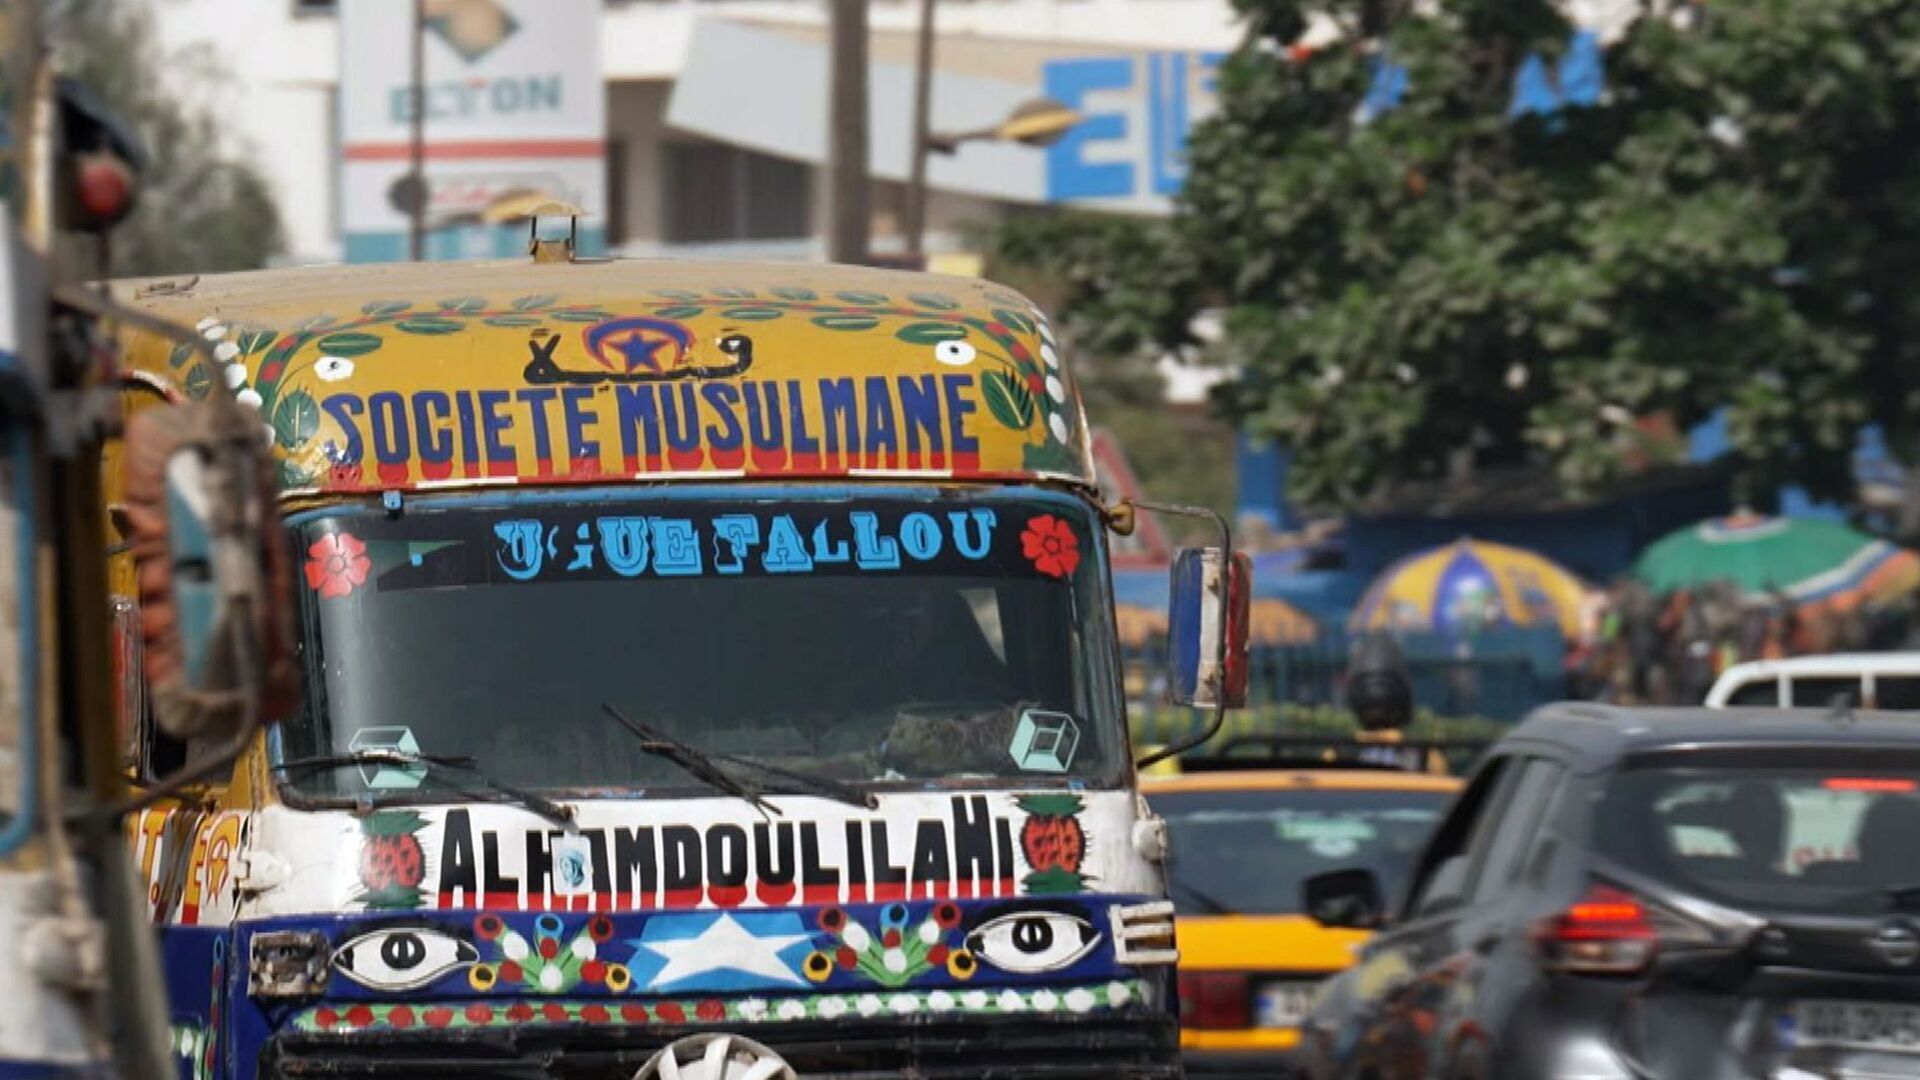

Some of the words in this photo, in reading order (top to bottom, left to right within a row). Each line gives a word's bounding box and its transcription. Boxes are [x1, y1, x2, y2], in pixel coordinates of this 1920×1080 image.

[321, 385, 602, 482] SOCIETE
[615, 374, 980, 471] MUSULMANE
[712, 508, 996, 573] FALLOU
